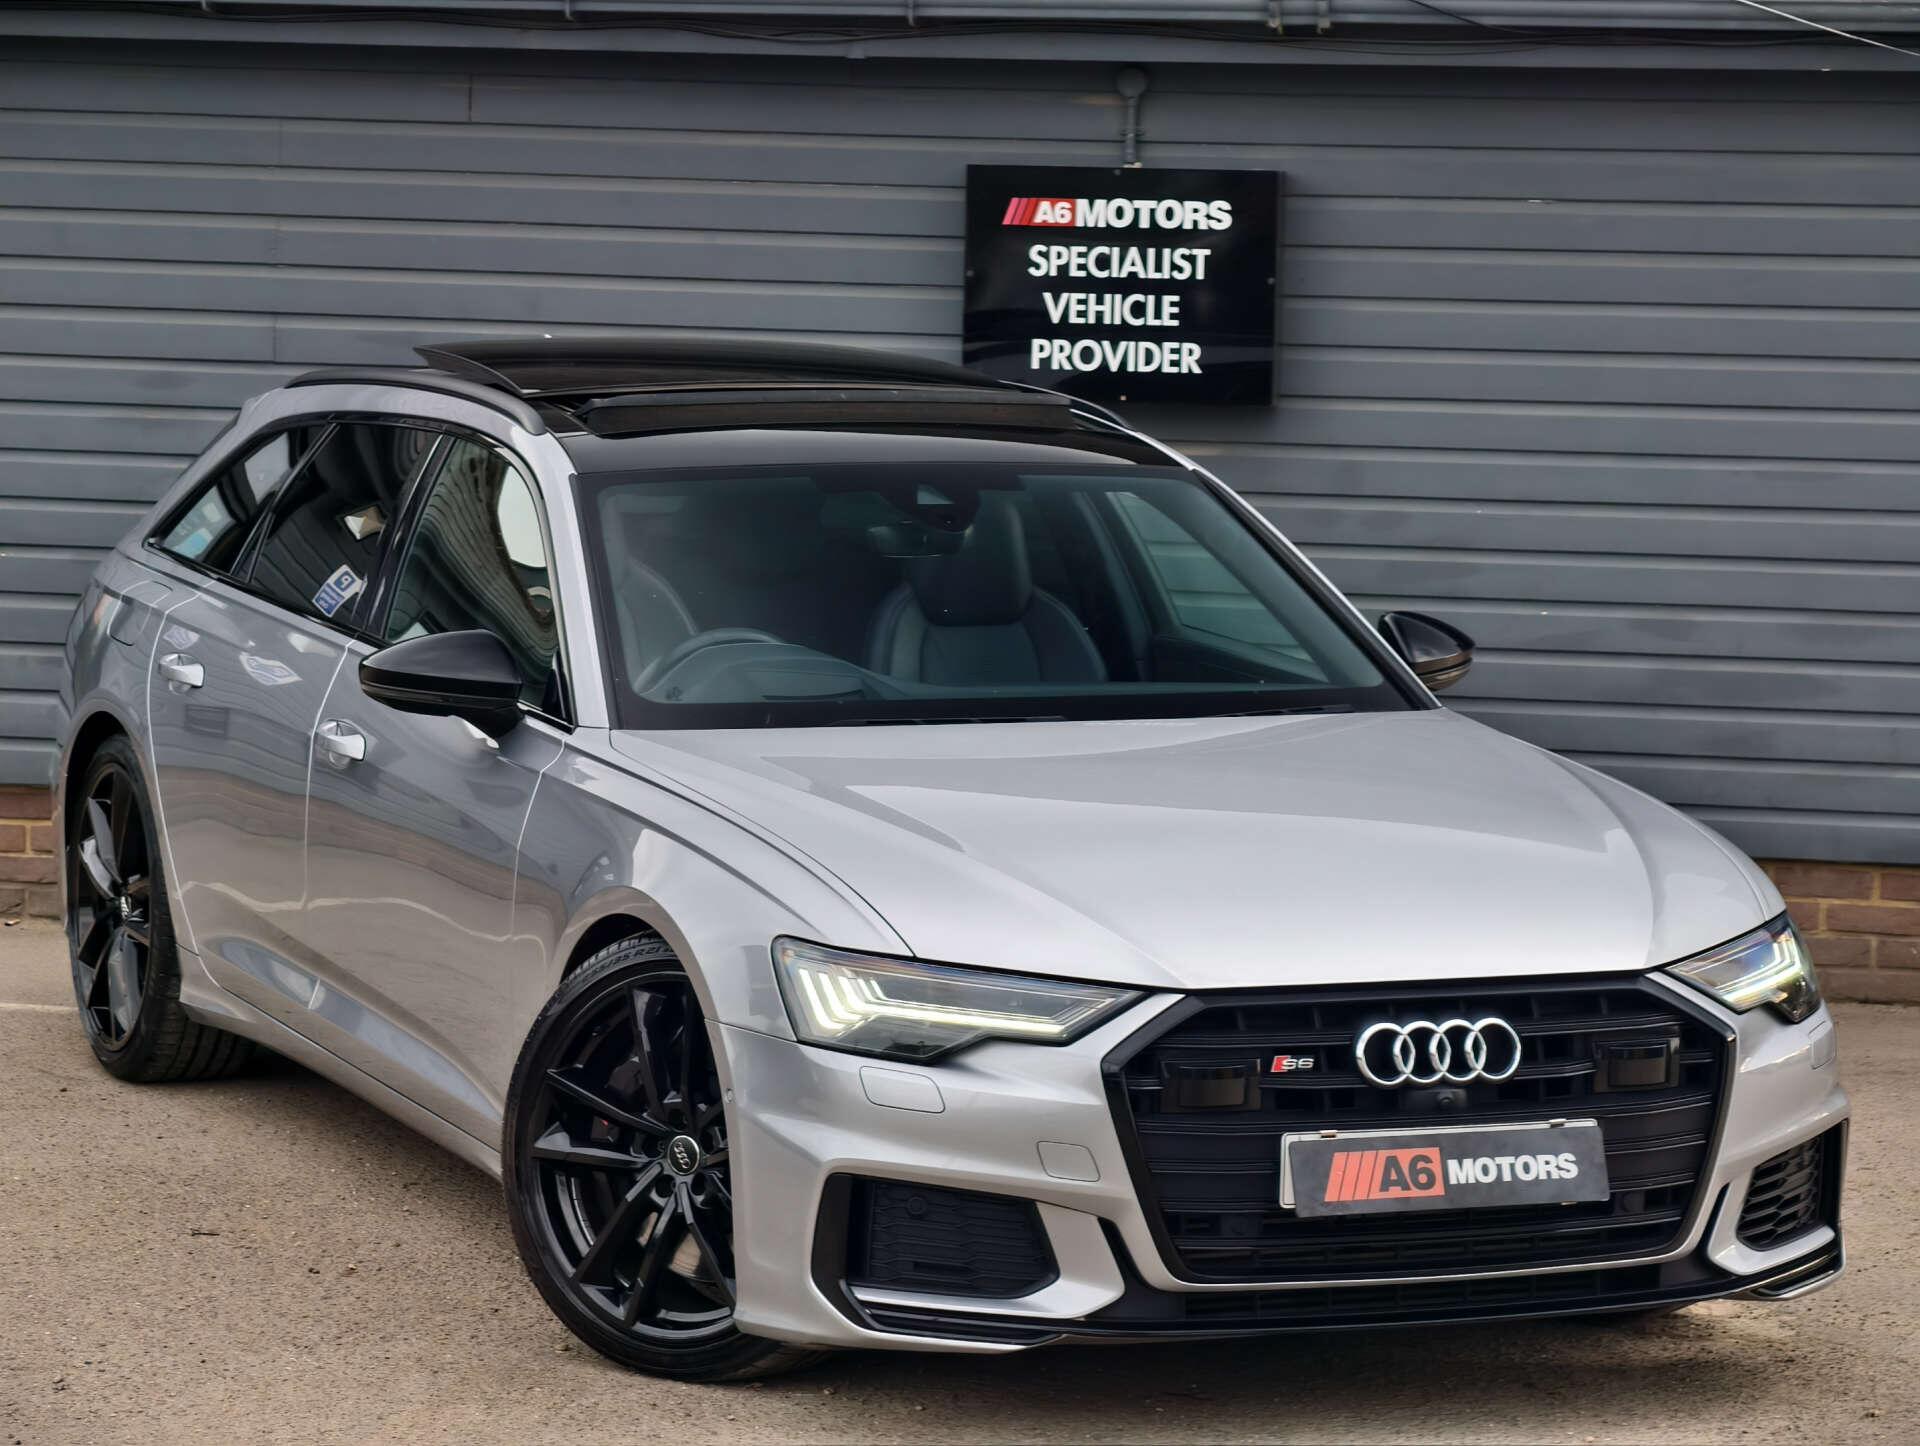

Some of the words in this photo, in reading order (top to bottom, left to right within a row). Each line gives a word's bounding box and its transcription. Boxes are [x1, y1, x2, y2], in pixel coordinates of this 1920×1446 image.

[1033, 200, 1073, 224] A6
[1074, 198, 1233, 230] MOTORS
[1027, 244, 1211, 280] SPECIALIST
[1042, 292, 1180, 326] VEHICLE
[1030, 338, 1202, 374] PROVIDER
[1379, 1154, 1437, 1193] A6
[1447, 1152, 1579, 1185] MOTORS
